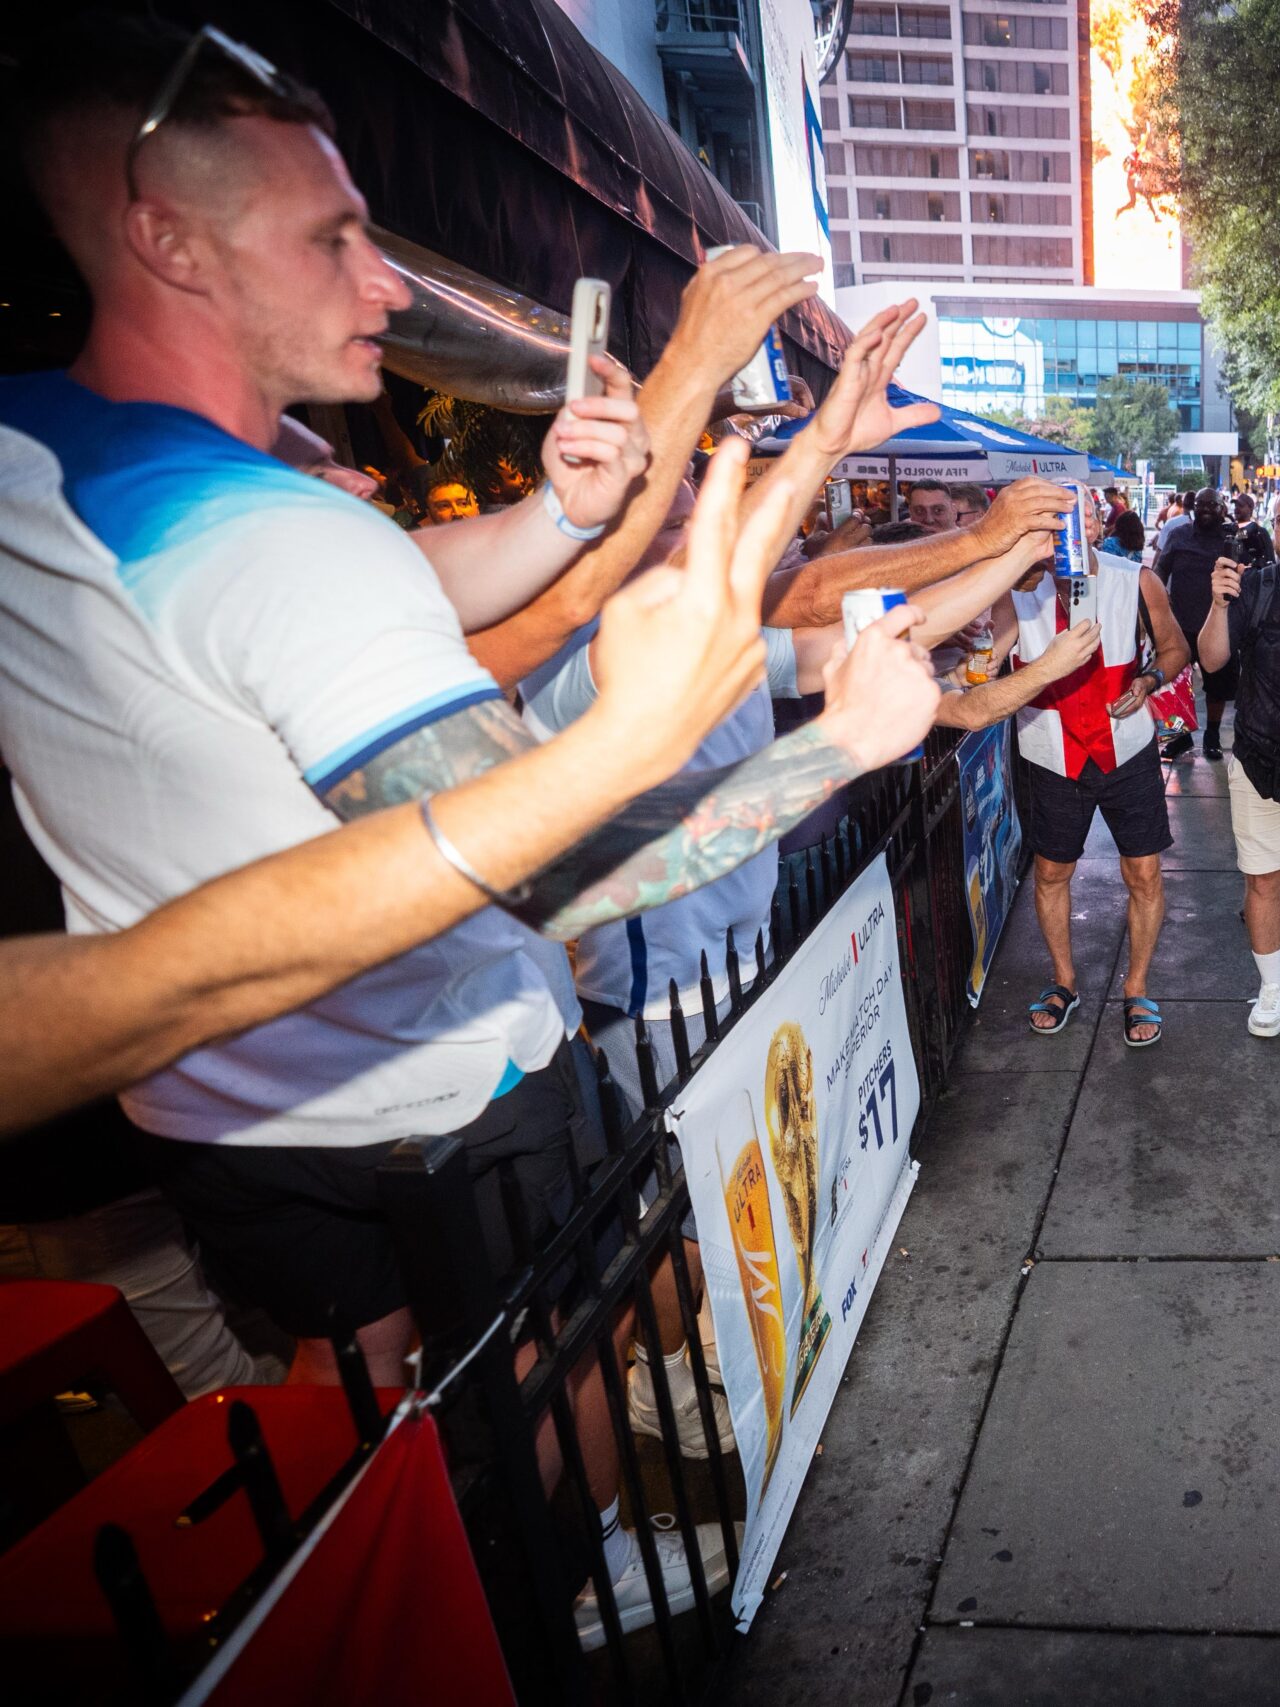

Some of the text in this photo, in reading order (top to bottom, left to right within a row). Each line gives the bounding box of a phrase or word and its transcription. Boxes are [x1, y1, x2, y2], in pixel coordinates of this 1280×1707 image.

[1039, 461, 1067, 473] ULTRA
[858, 901, 885, 951] ULTRA
[826, 1036, 850, 1093] MAKE
[876, 961, 893, 996] DAY
[857, 1039, 892, 1105] PITCHERS
[858, 1058, 898, 1153] $17
[734, 1163, 763, 1224] ULTRA
[841, 1275, 857, 1323] FOX
